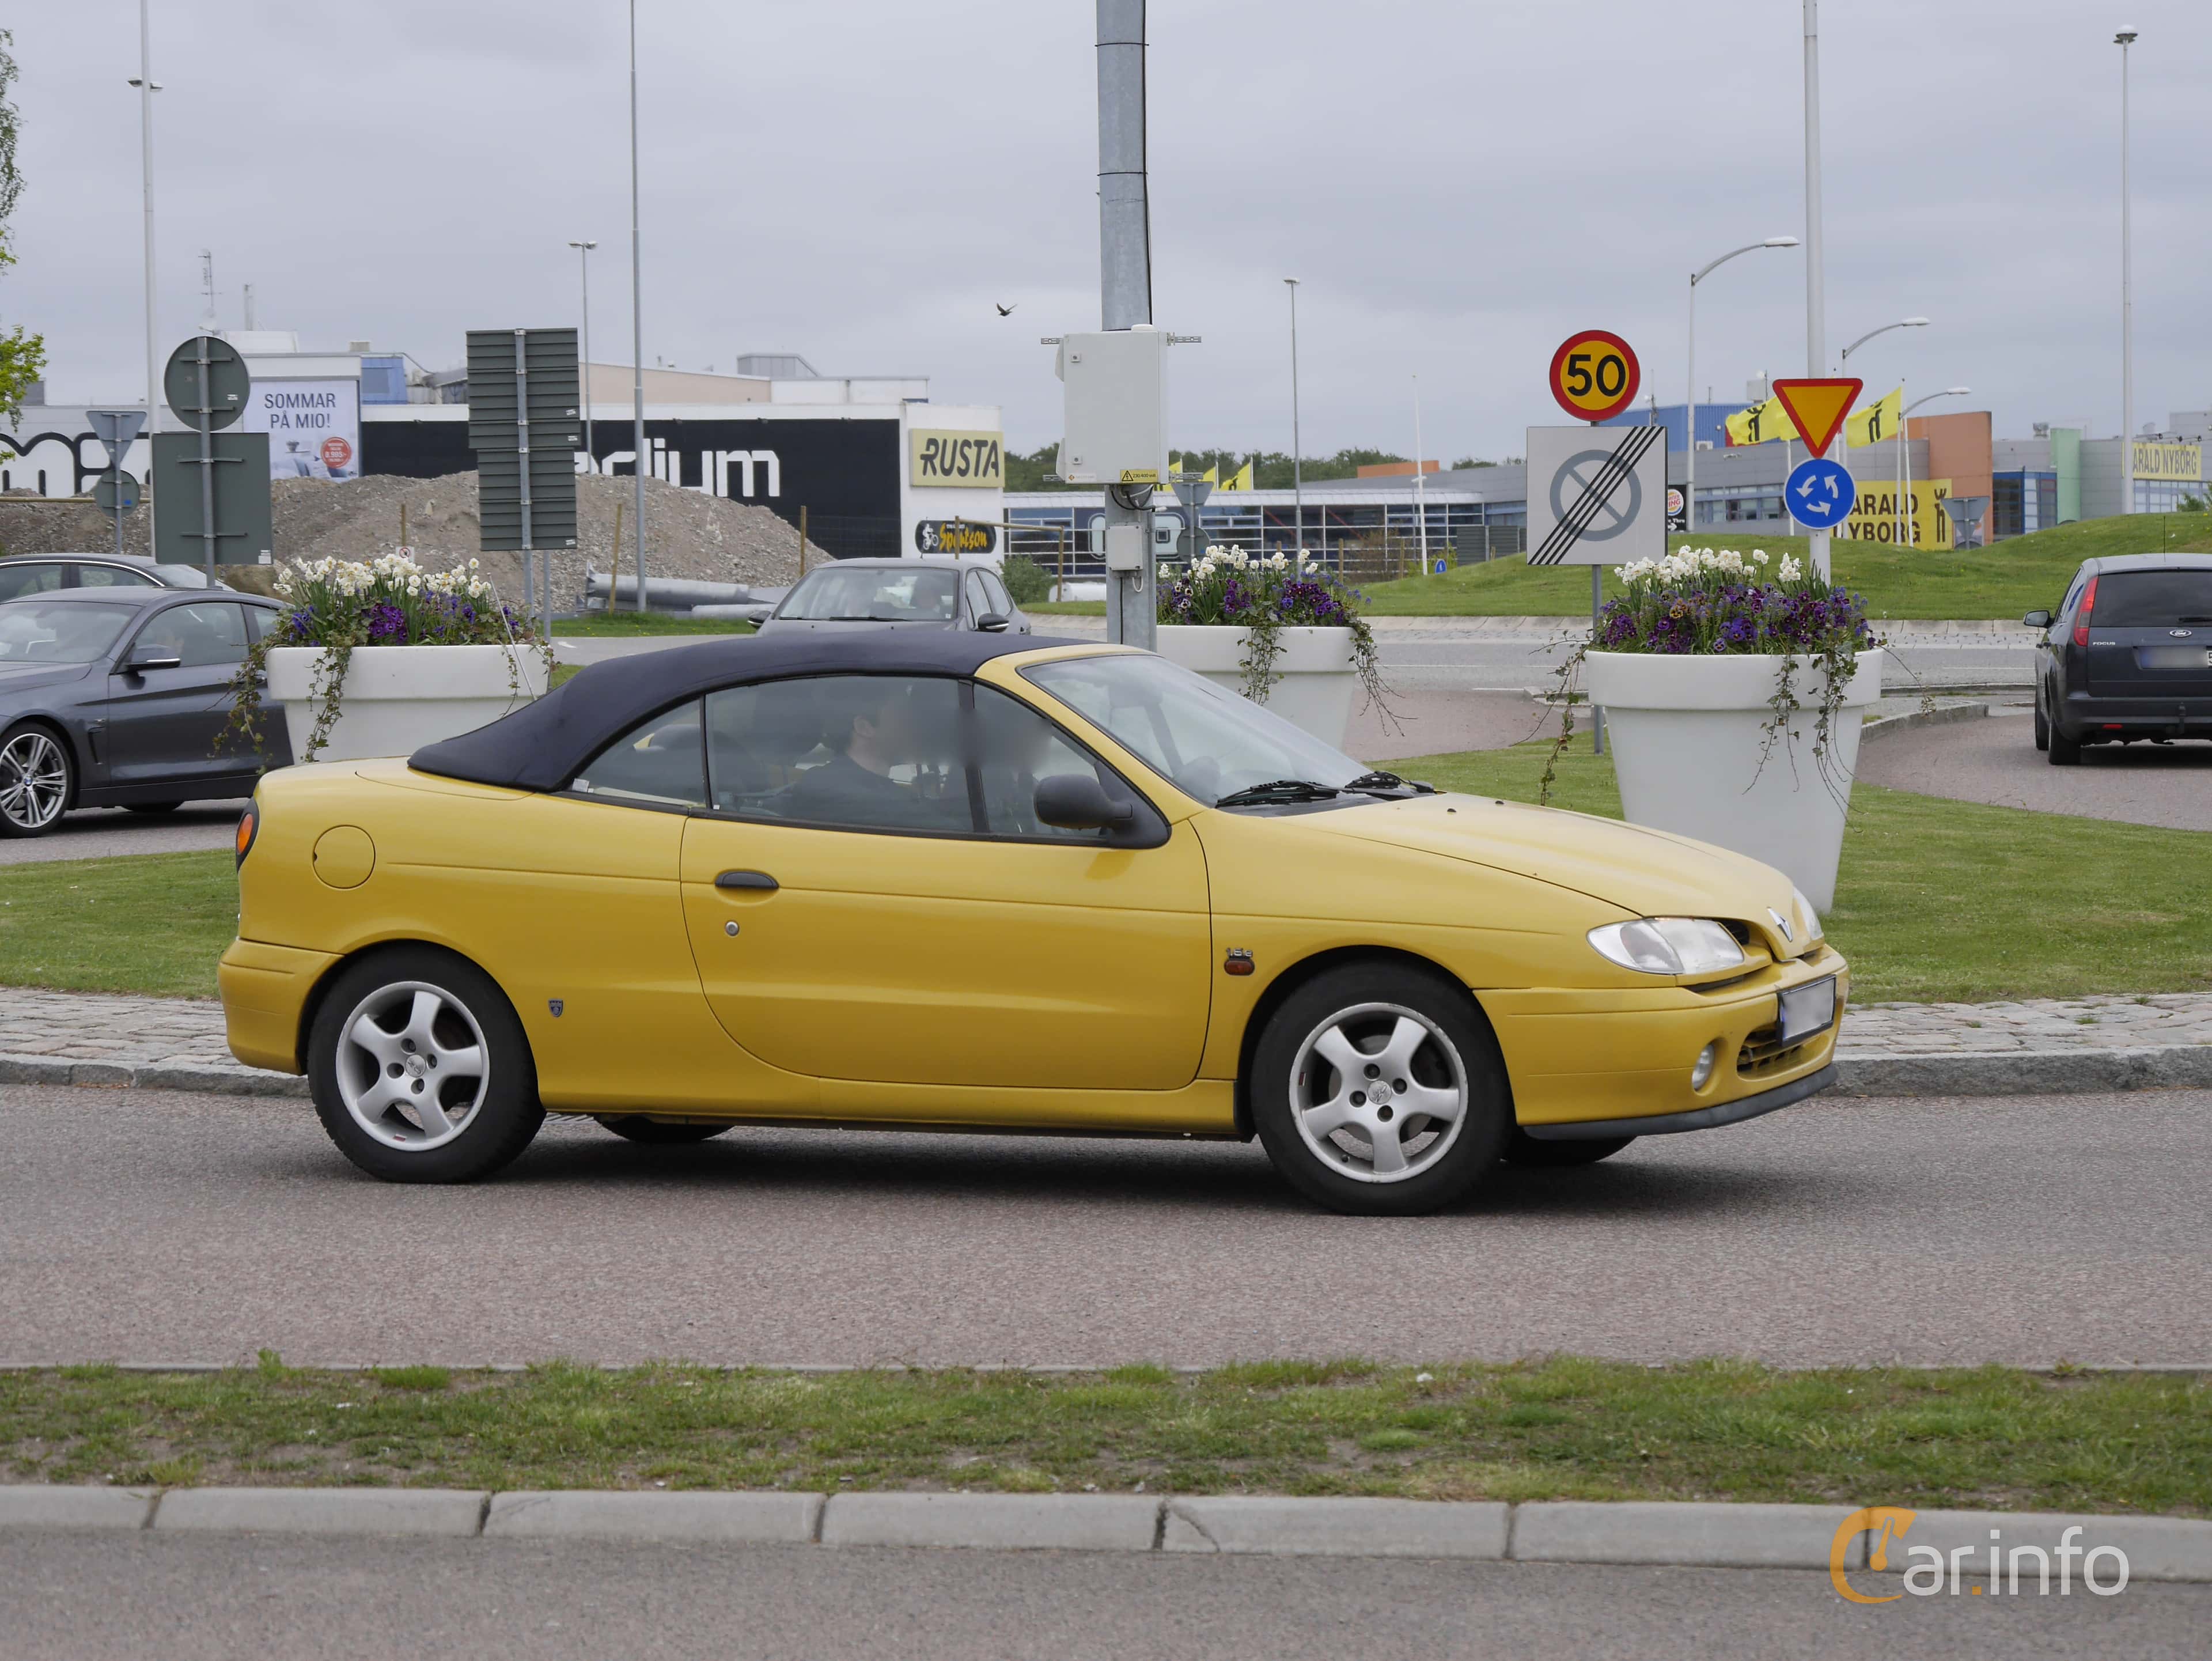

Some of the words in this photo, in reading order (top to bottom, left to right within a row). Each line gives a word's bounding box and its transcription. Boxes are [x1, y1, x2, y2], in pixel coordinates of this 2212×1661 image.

[1567, 354, 1626, 396] 50
[264, 393, 336, 408] SOMMAR
[270, 410, 290, 429] PÅ
[296, 413, 331, 428] MIO!
[574, 438, 780, 497] dium
[920, 438, 999, 478] RUSTA
[2133, 448, 2160, 473] ARALD
[2163, 449, 2196, 475] NYBORG
[1668, 499, 1680, 508] ING
[1850, 494, 1918, 515] ARALD
[1834, 521, 1921, 543] YBORG
